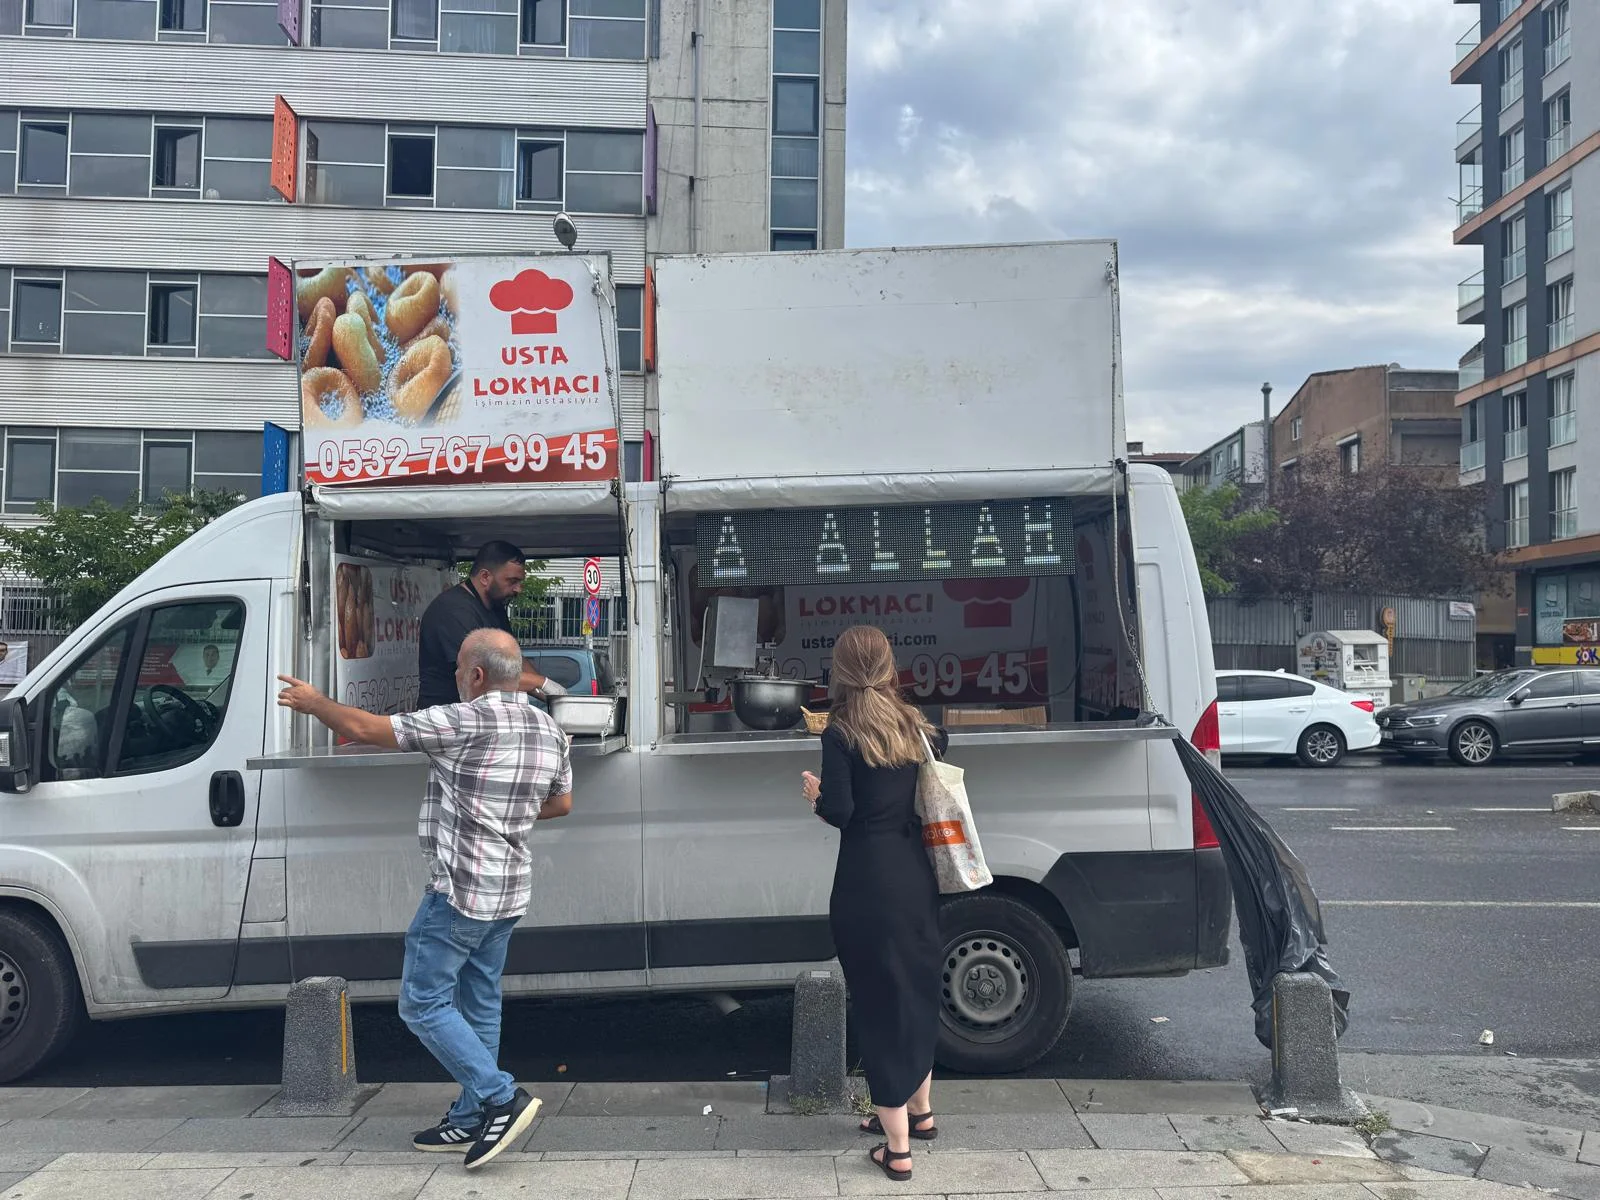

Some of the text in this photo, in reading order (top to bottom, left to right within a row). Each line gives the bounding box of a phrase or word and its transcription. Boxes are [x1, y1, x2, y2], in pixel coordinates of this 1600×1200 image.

[501, 345, 568, 366] USTA
[473, 375, 599, 397] LOKMACI
[318, 432, 607, 479] 0532 767 99 45
[713, 504, 1061, 578] A ALLAH
[389, 576, 421, 605] USTA
[587, 570, 598, 585] 30
[798, 594, 933, 617] LOKMACI
[911, 653, 963, 697] 99
[976, 652, 1029, 695] 45
